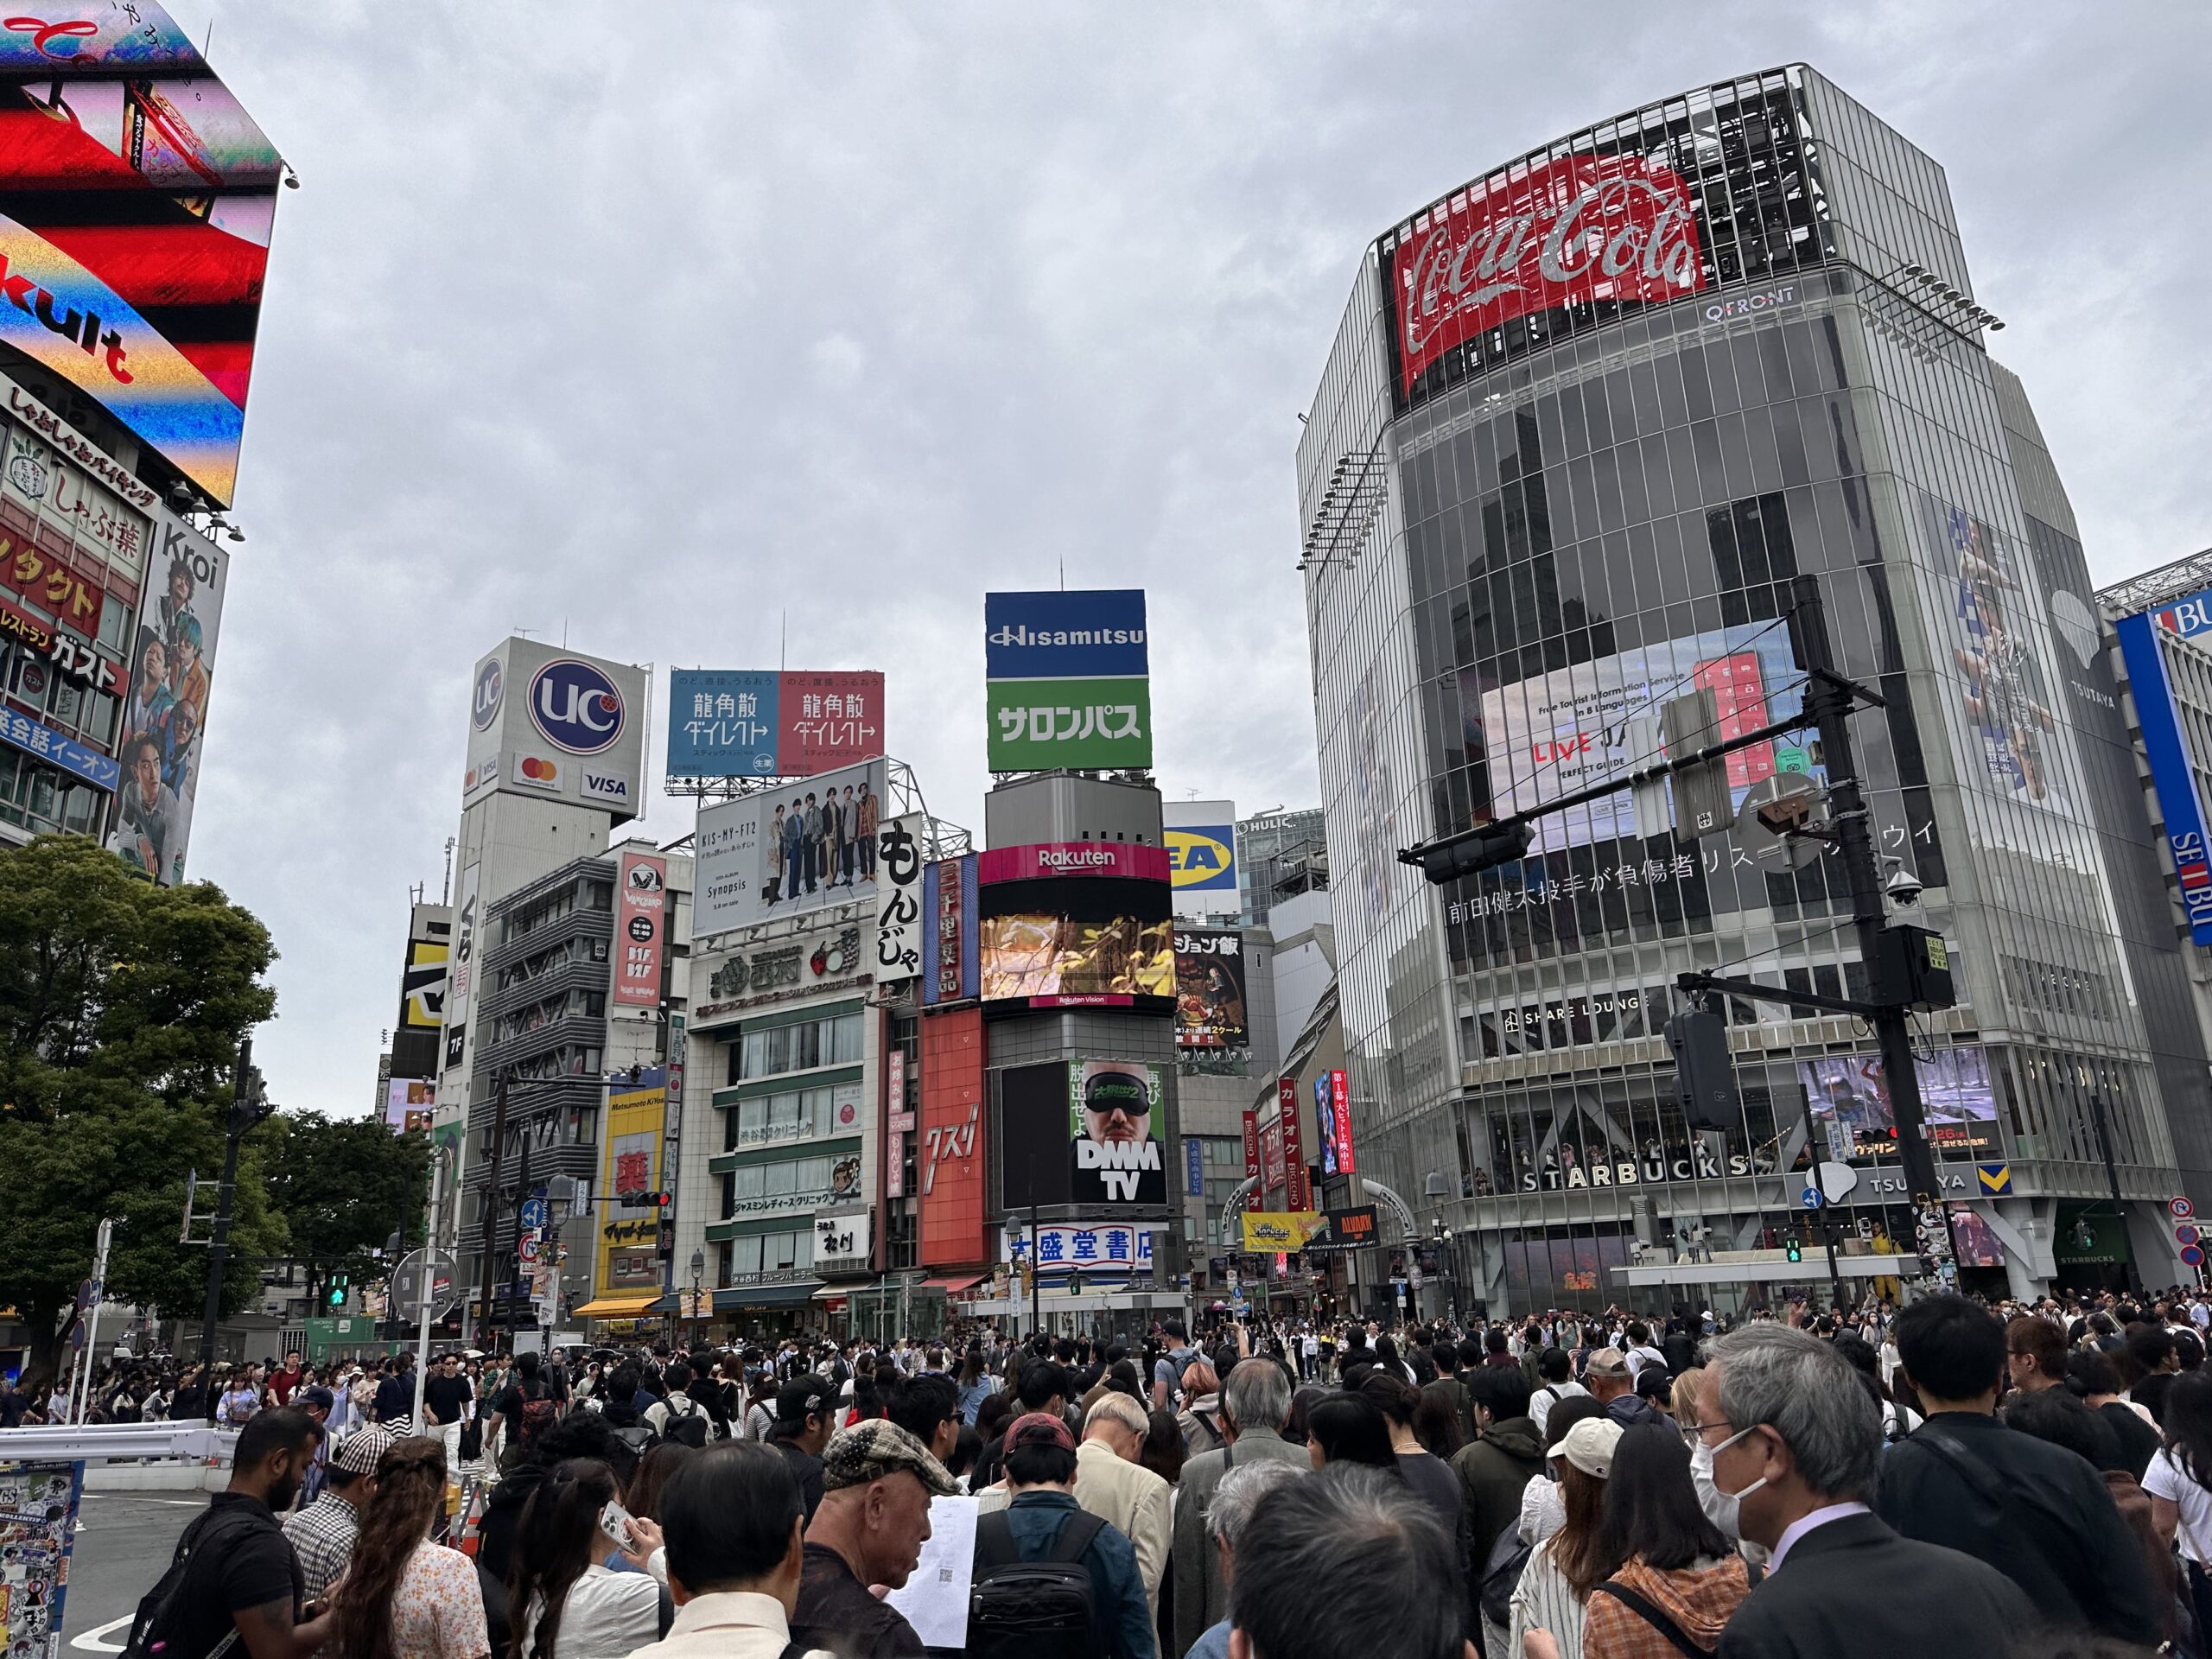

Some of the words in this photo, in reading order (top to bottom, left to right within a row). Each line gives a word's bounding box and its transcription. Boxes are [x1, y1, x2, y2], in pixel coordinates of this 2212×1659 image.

[12, 386, 157, 507] しゃぶしゃぶバイキング
[55, 474, 140, 558] しゃぶ葉
[162, 521, 219, 590] Kroi
[990, 625, 1144, 647] Hisamitsu
[52, 632, 116, 687] ガスト
[25, 673, 43, 688] ガスト
[1538, 702, 1558, 715] Free
[1560, 694, 1587, 709] Tourist
[1591, 681, 1646, 702] Information
[1649, 671, 1685, 686] Service
[694, 692, 758, 718] 龍角散
[803, 693, 865, 719] 龍角散
[1595, 693, 1648, 712] Languages
[2071, 680, 2116, 710] TSUTAYA
[683, 721, 768, 746] ダイレクト
[793, 721, 875, 746] ダイレクト
[998, 704, 1141, 742] サロンパス
[0, 710, 116, 781] 英会話イーオン
[1534, 731, 1591, 763] LIVE
[483, 759, 496, 776] VISA
[753, 759, 773, 768] 生薬
[1560, 763, 1593, 779] ERFECT
[521, 777, 556, 788] mastercard
[585, 774, 626, 796] VISA
[702, 821, 756, 848] KIS-MY-FT2
[1251, 817, 1290, 832] HULIC
[1039, 849, 1116, 867] Rakuten
[708, 880, 747, 899] Synopsis
[2171, 831, 2212, 927] SEIBU
[878, 820, 919, 973] もんじゃ
[627, 945, 652, 963] B1F
[1174, 934, 1239, 956] ジョン飯
[626, 962, 652, 979] B2F
[749, 957, 802, 990] 西村
[1525, 1006, 1575, 1025] SHARE
[1582, 995, 1649, 1016] LOUNGE
[450, 1036, 463, 1053] 7F
[1071, 1064, 1087, 1136] 脱出せよ
[1147, 1071, 1161, 1105] 再び
[611, 1099, 647, 1112] Matsumoto
[1281, 1087, 1298, 1155] カラオケ
[1077, 1140, 1161, 1171] DMM
[615, 1150, 650, 1195] 薬
[1523, 1154, 1748, 1193] STARBUCKS
[1870, 1175, 1966, 1193] TSUYA
[1100, 1171, 1141, 1201] TV
[1341, 1214, 1372, 1233] ALVARK
[823, 1231, 854, 1254] 松川
[2060, 1255, 2115, 1264] STARBUCKS
[734, 1274, 760, 1283] 渋谷西村
[762, 1271, 813, 1282] フルーツパーラー
